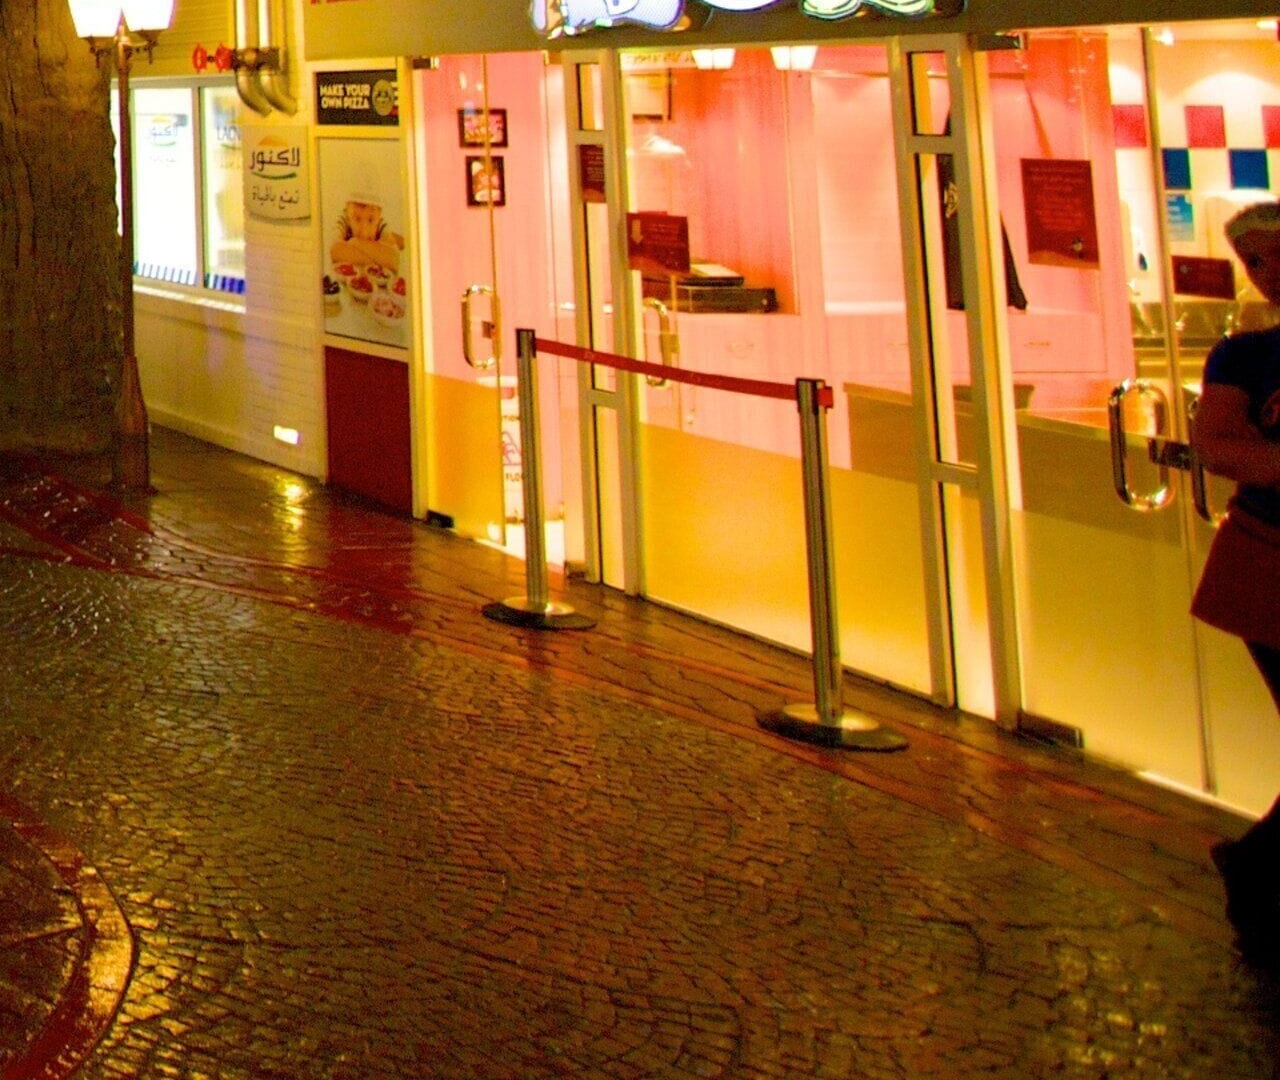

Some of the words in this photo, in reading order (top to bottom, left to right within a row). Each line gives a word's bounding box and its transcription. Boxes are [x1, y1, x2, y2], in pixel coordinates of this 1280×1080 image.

[320, 84, 344, 96] MAKE
[345, 83, 371, 96] YOUR
[321, 97, 342, 109] OWN
[343, 96, 370, 109] PIZZA
